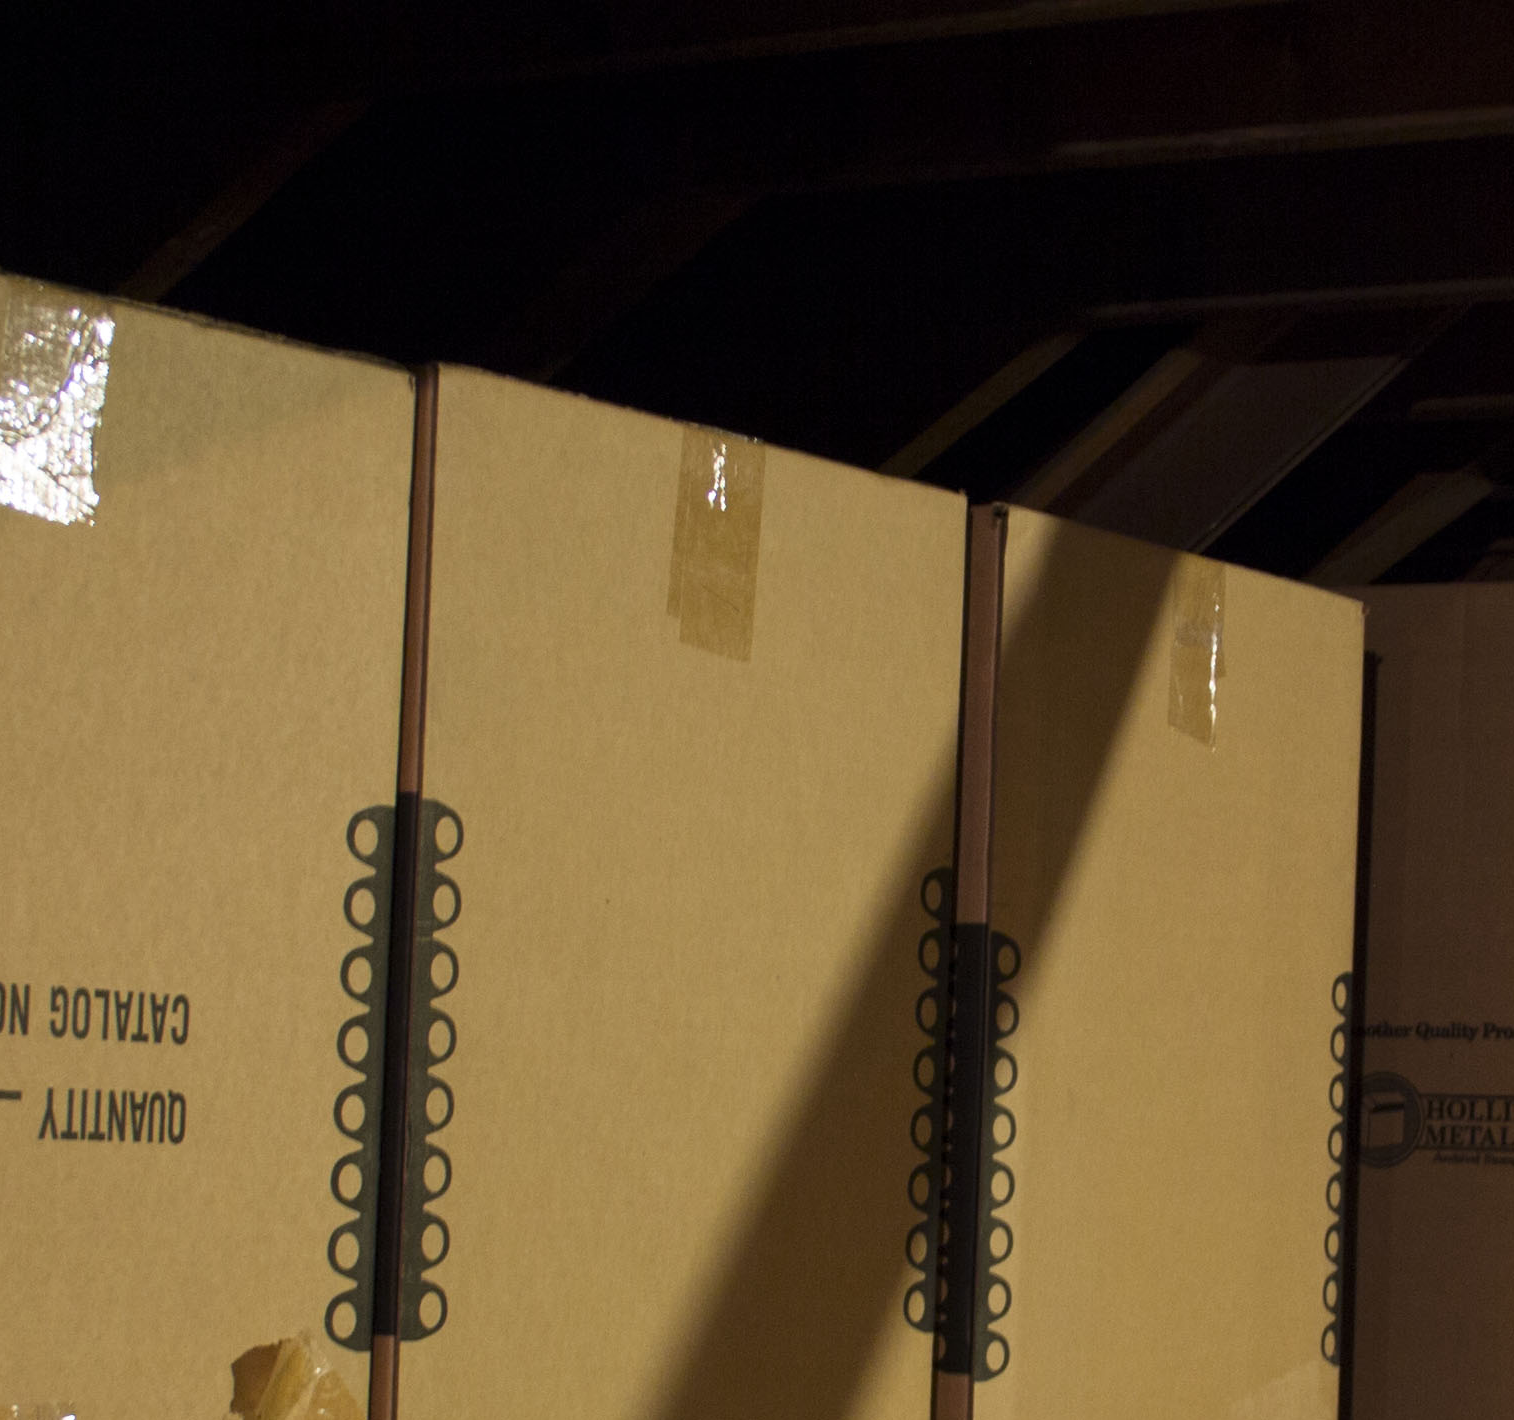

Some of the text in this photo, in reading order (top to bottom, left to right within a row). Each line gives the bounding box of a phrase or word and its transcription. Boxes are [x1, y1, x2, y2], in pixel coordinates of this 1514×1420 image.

[49, 985, 191, 1045] CATALOG
[1415, 1021, 1478, 1041] Quality
[38, 1087, 187, 1145] QUANTITY
